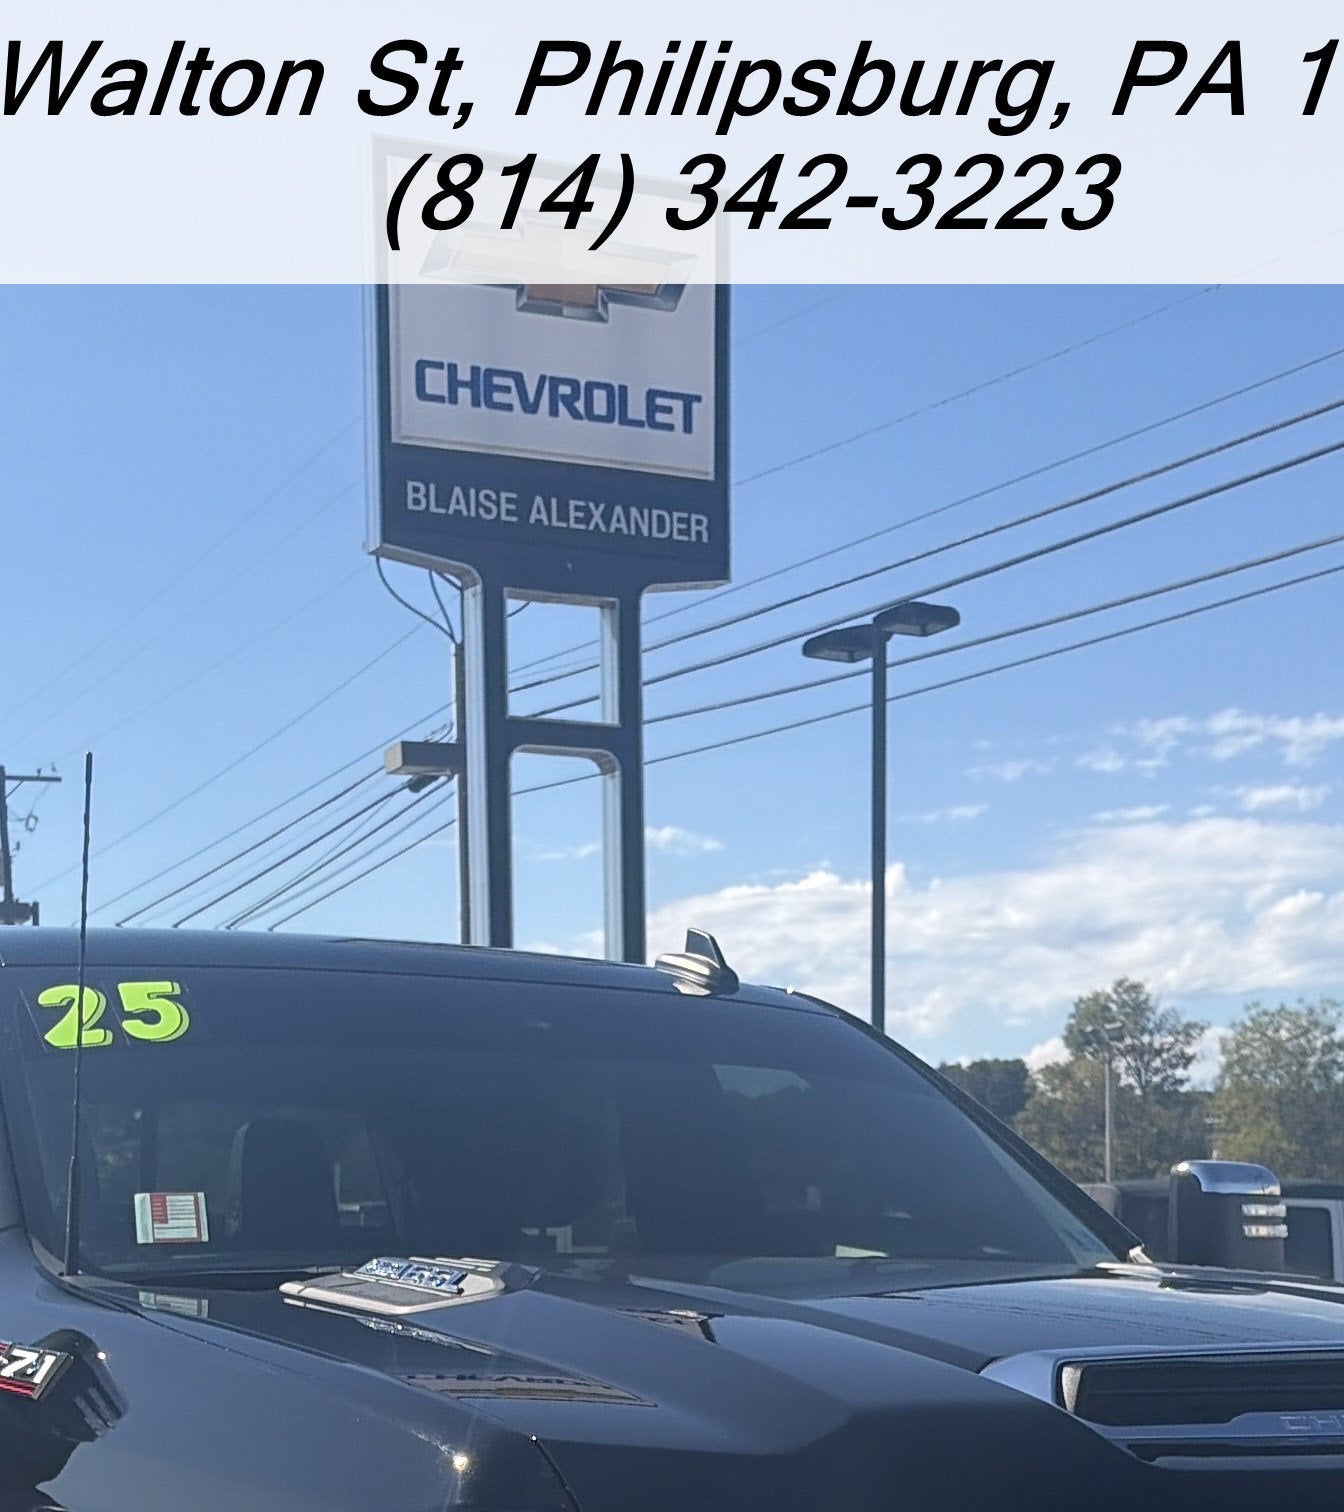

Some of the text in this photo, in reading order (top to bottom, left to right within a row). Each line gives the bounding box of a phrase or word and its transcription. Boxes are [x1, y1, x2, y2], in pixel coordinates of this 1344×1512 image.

[414, 358, 703, 435] CHEVROLET
[406, 480, 709, 544] BLAISE ALEXANDER
[38, 981, 190, 1049] 25
